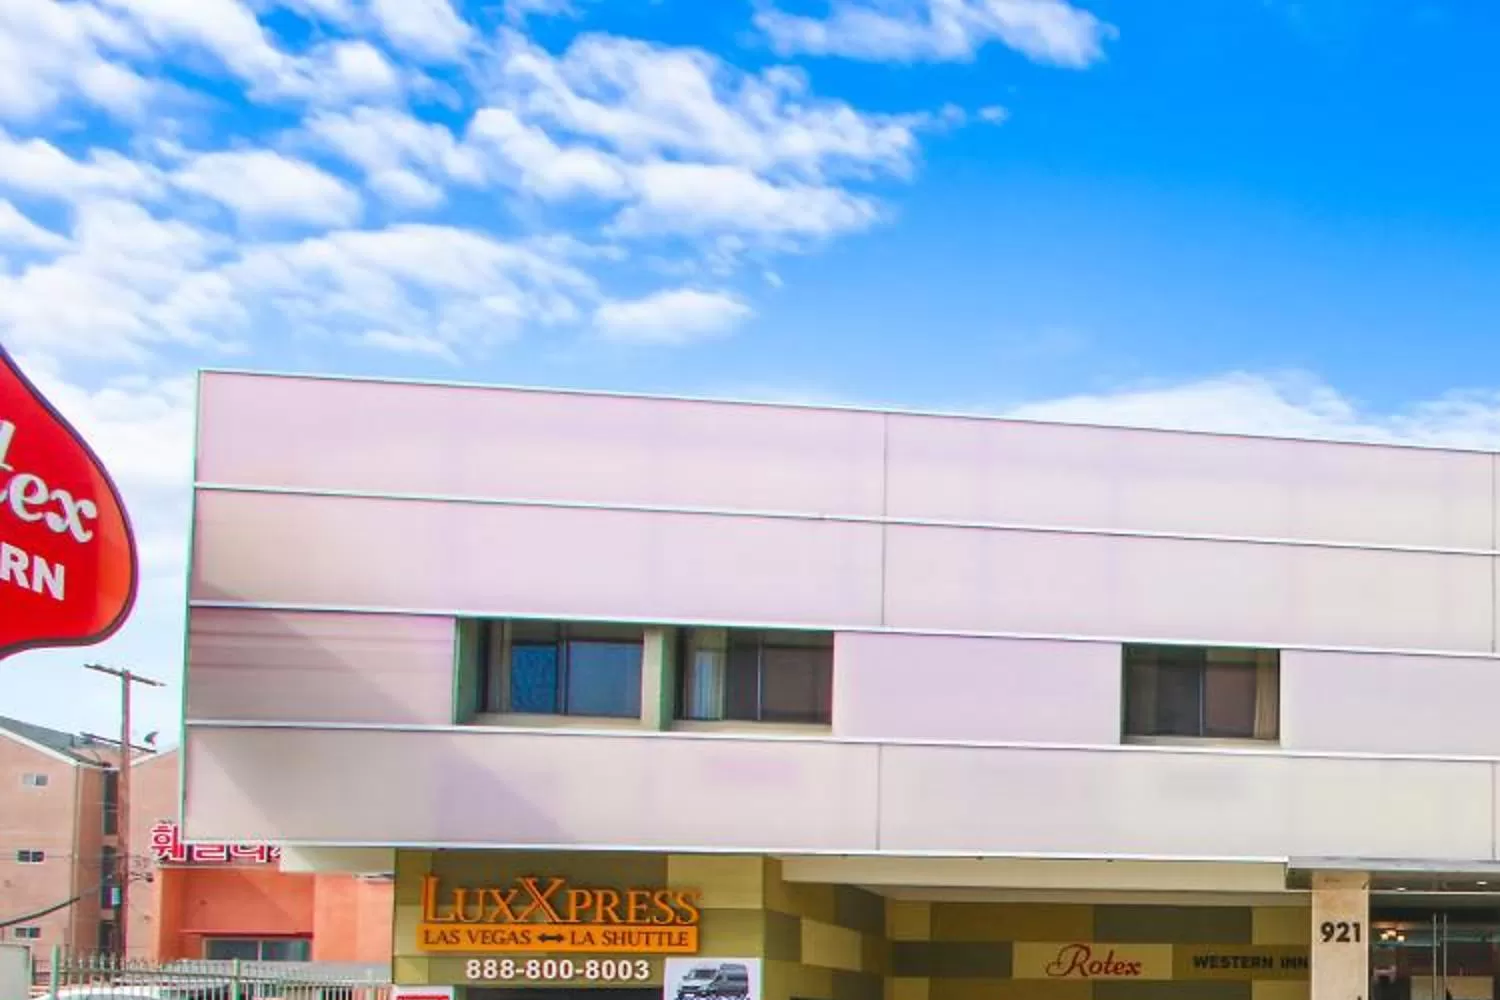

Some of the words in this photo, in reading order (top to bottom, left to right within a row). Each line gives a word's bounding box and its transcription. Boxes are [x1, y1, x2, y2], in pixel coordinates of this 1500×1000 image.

[424, 929, 460, 945] LAS
[467, 929, 532, 945] VEGAS
[571, 931, 595, 946] LA
[602, 931, 689, 947] SHUTTLE
[1320, 921, 1361, 943] 921
[465, 959, 649, 980] 888-800-8003
[1046, 943, 1143, 978] Rotex
[1192, 955, 1273, 969] WESTERN
